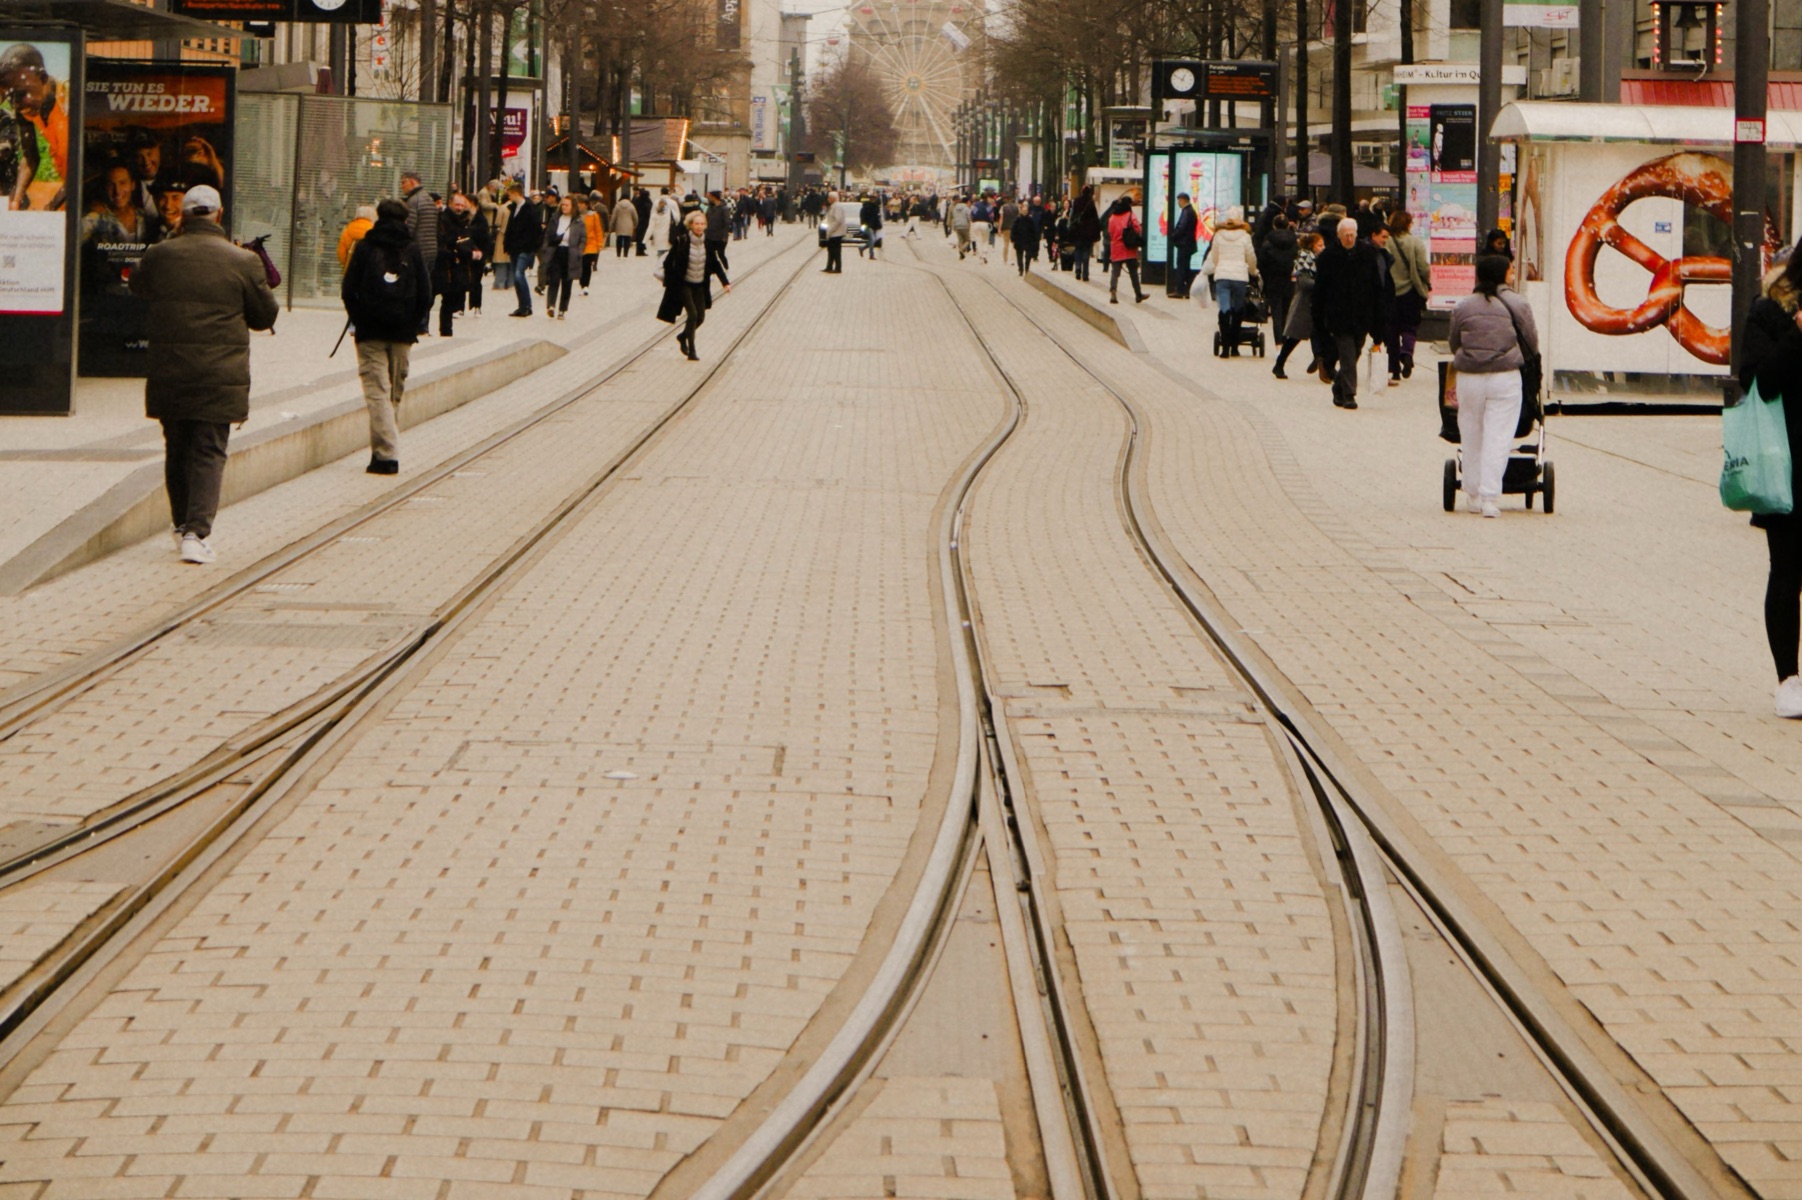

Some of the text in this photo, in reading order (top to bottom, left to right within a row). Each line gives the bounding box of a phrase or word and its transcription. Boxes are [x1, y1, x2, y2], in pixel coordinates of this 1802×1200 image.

[1425, 70, 1452, 79] Kultur
[1455, 70, 1467, 78] im
[86, 82, 165, 93] SIE TUN ES
[107, 94, 215, 113] WIEDER.
